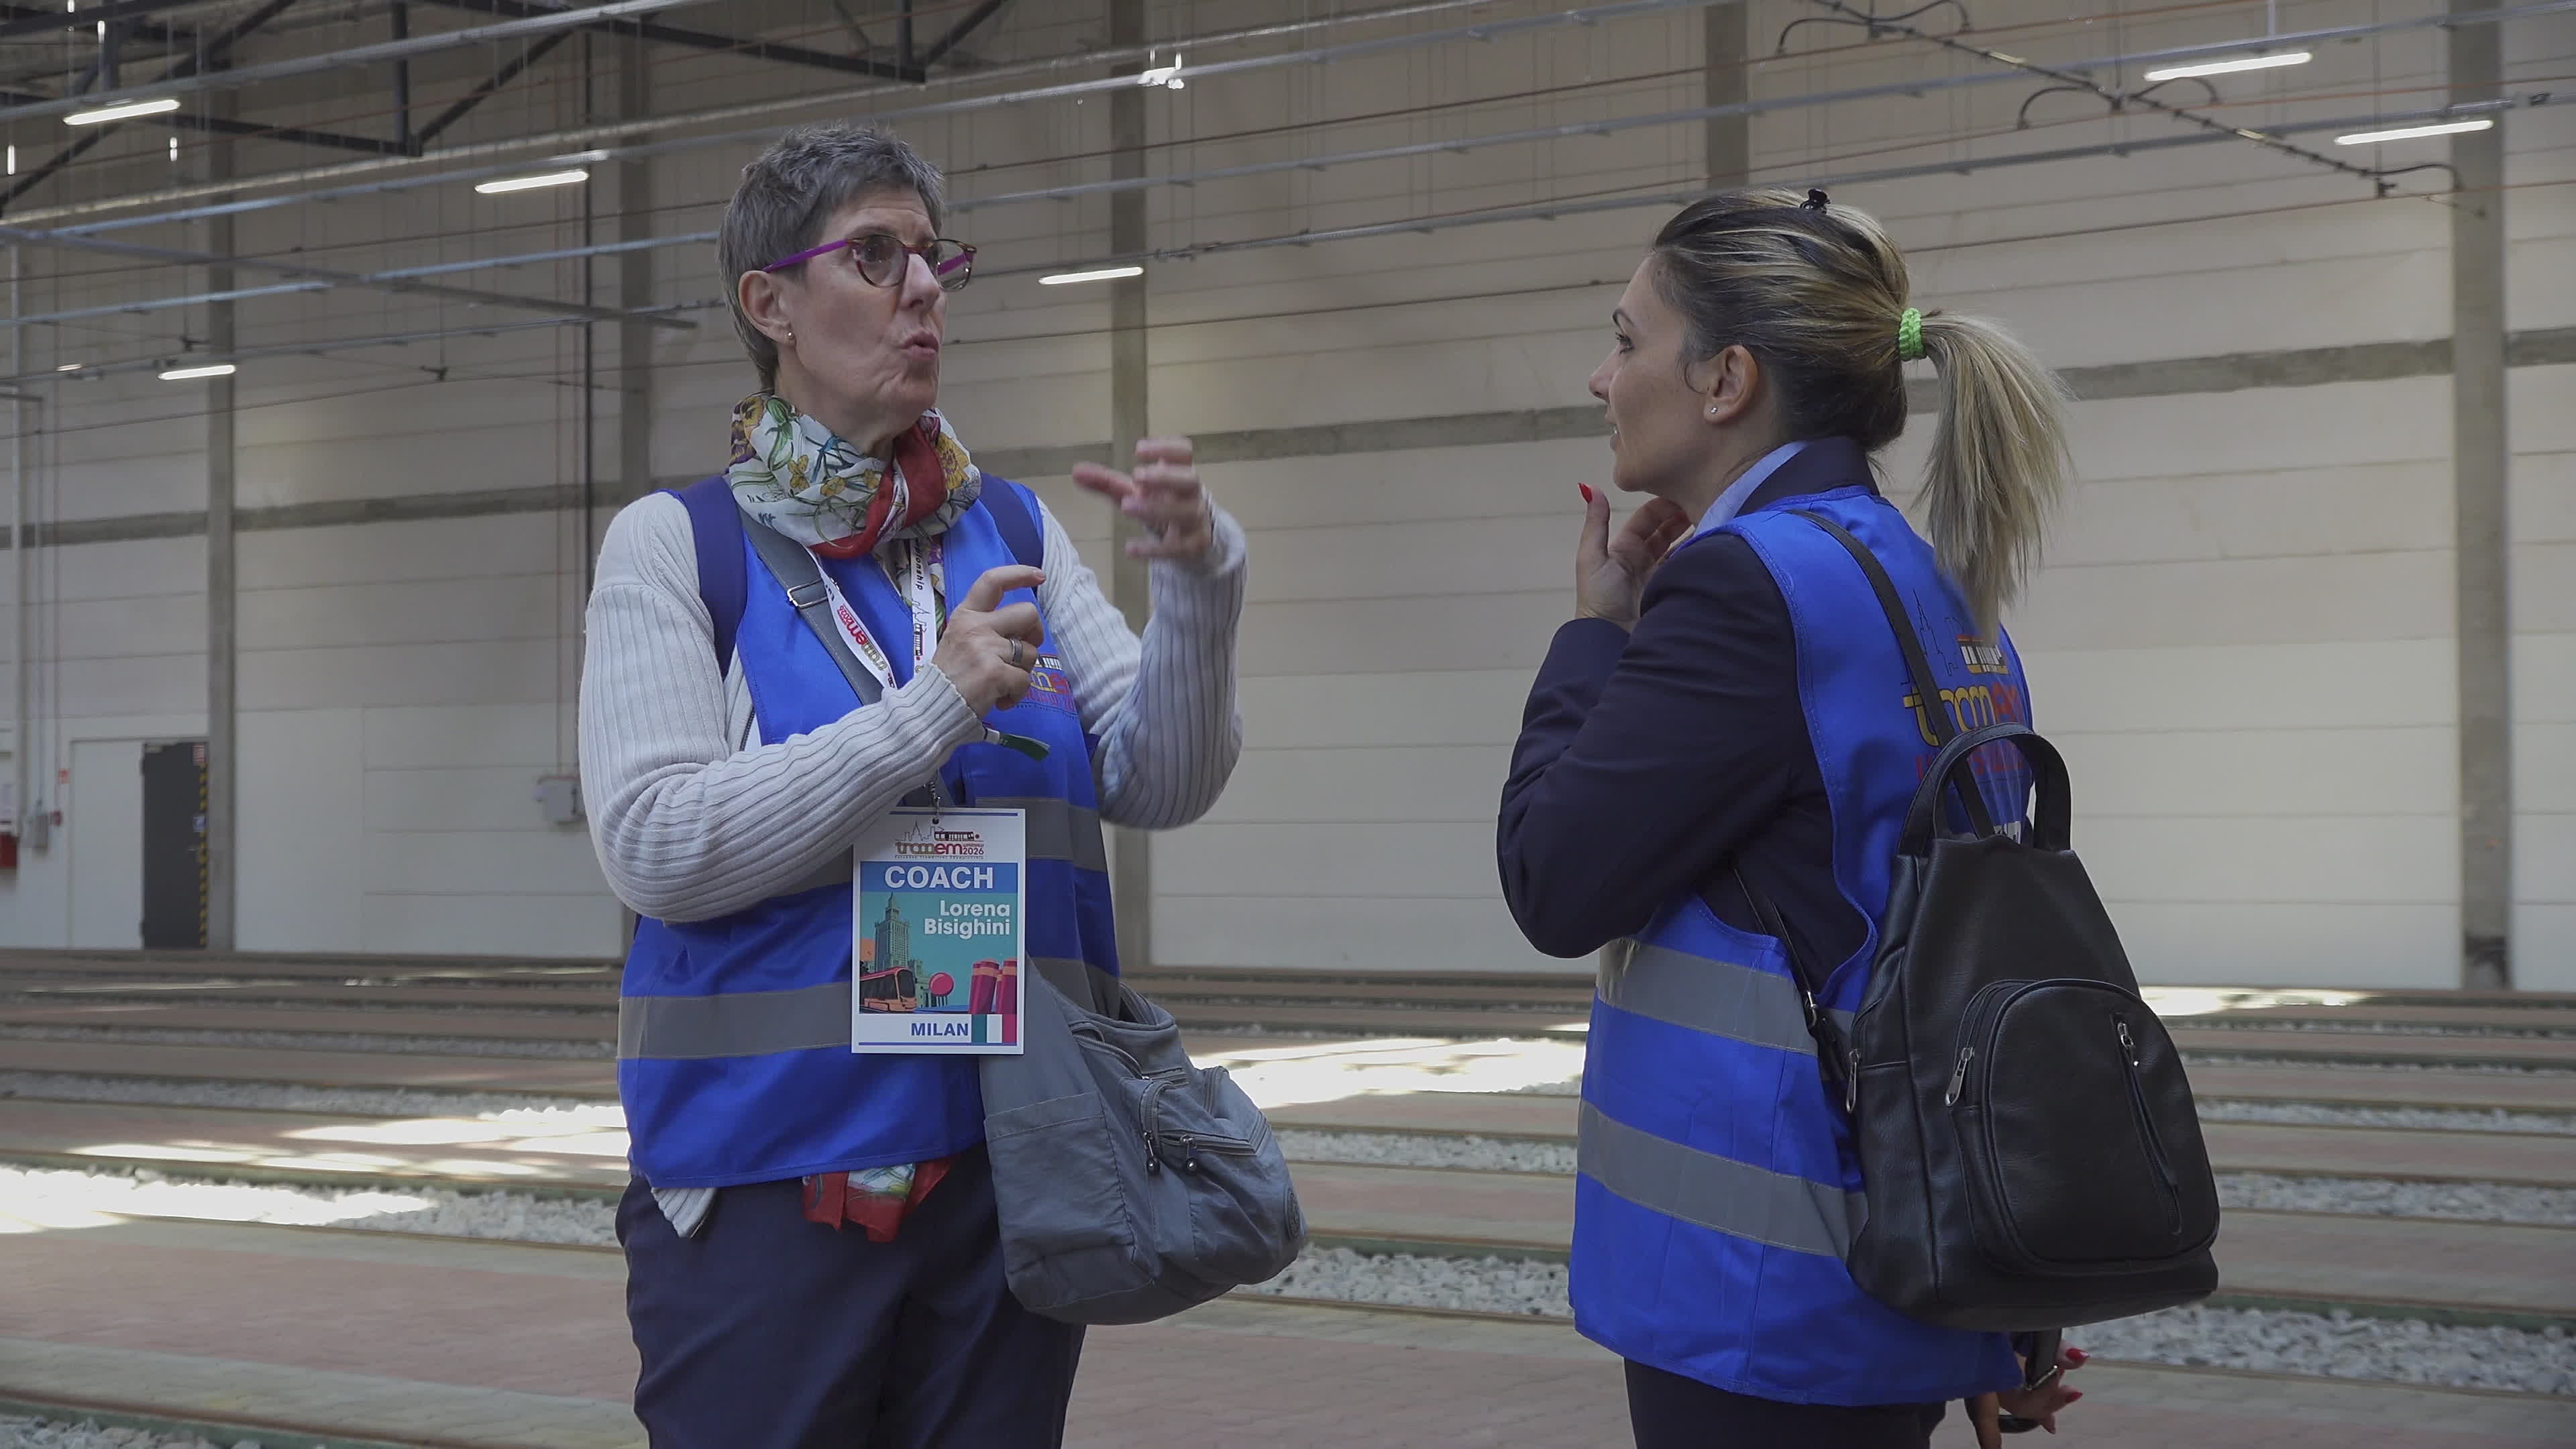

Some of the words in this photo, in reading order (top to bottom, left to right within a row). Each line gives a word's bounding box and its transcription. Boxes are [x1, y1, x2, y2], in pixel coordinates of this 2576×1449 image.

[839, 604, 852, 624] 2026
[963, 847, 985, 855] 2026
[885, 865, 994, 890] COACH
[940, 900, 1010, 916] Lorena
[924, 918, 1010, 939] Bisighini
[911, 1022, 969, 1036] MILAN
